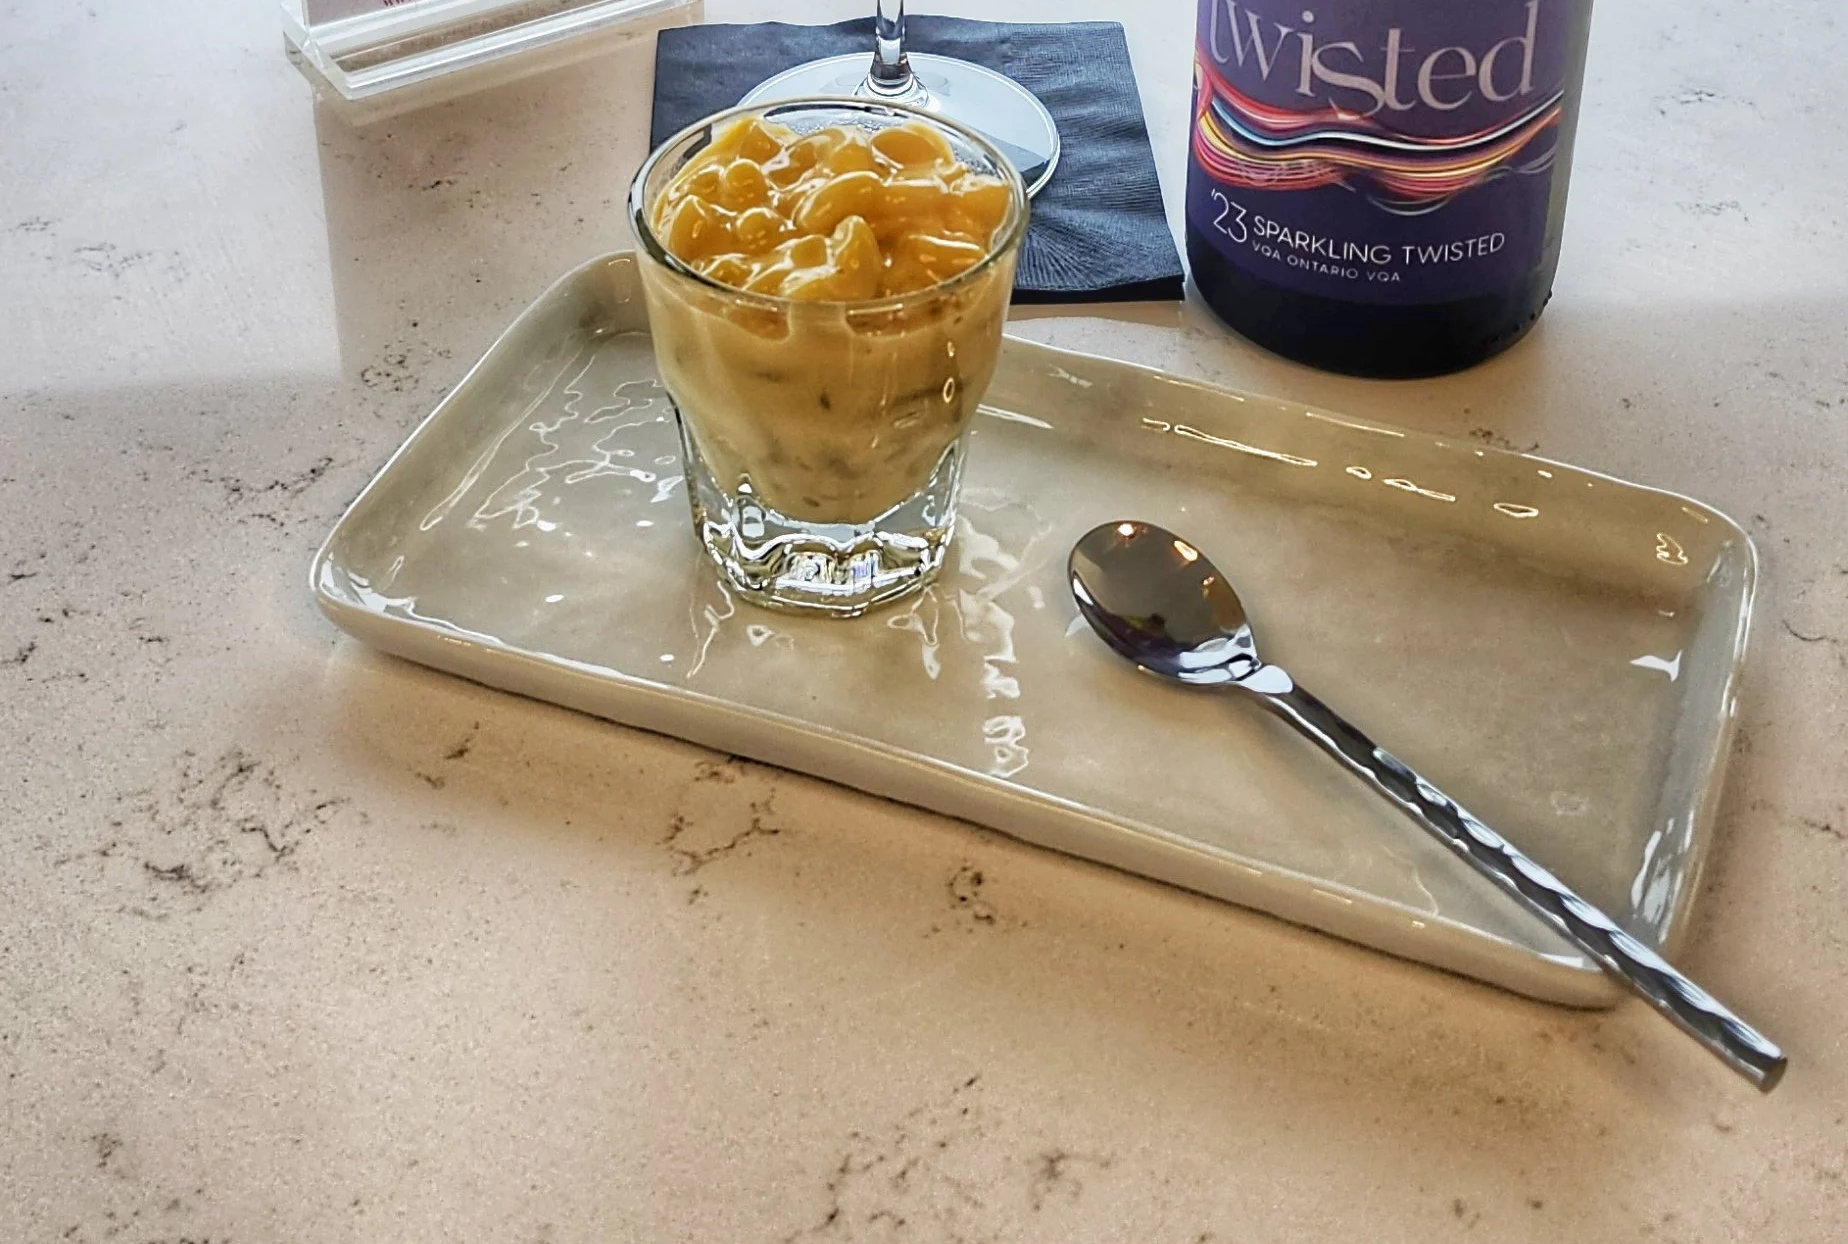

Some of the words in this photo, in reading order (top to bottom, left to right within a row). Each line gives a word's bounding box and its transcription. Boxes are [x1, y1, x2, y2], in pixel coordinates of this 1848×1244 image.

[1211, 188, 1248, 243] '23
[1253, 215, 1392, 265] SPARKLING
[1402, 232, 1505, 266] TWISTED
[1252, 240, 1281, 260] VQA
[1287, 255, 1358, 280] ONTARIO
[1366, 271, 1401, 282] VQA
